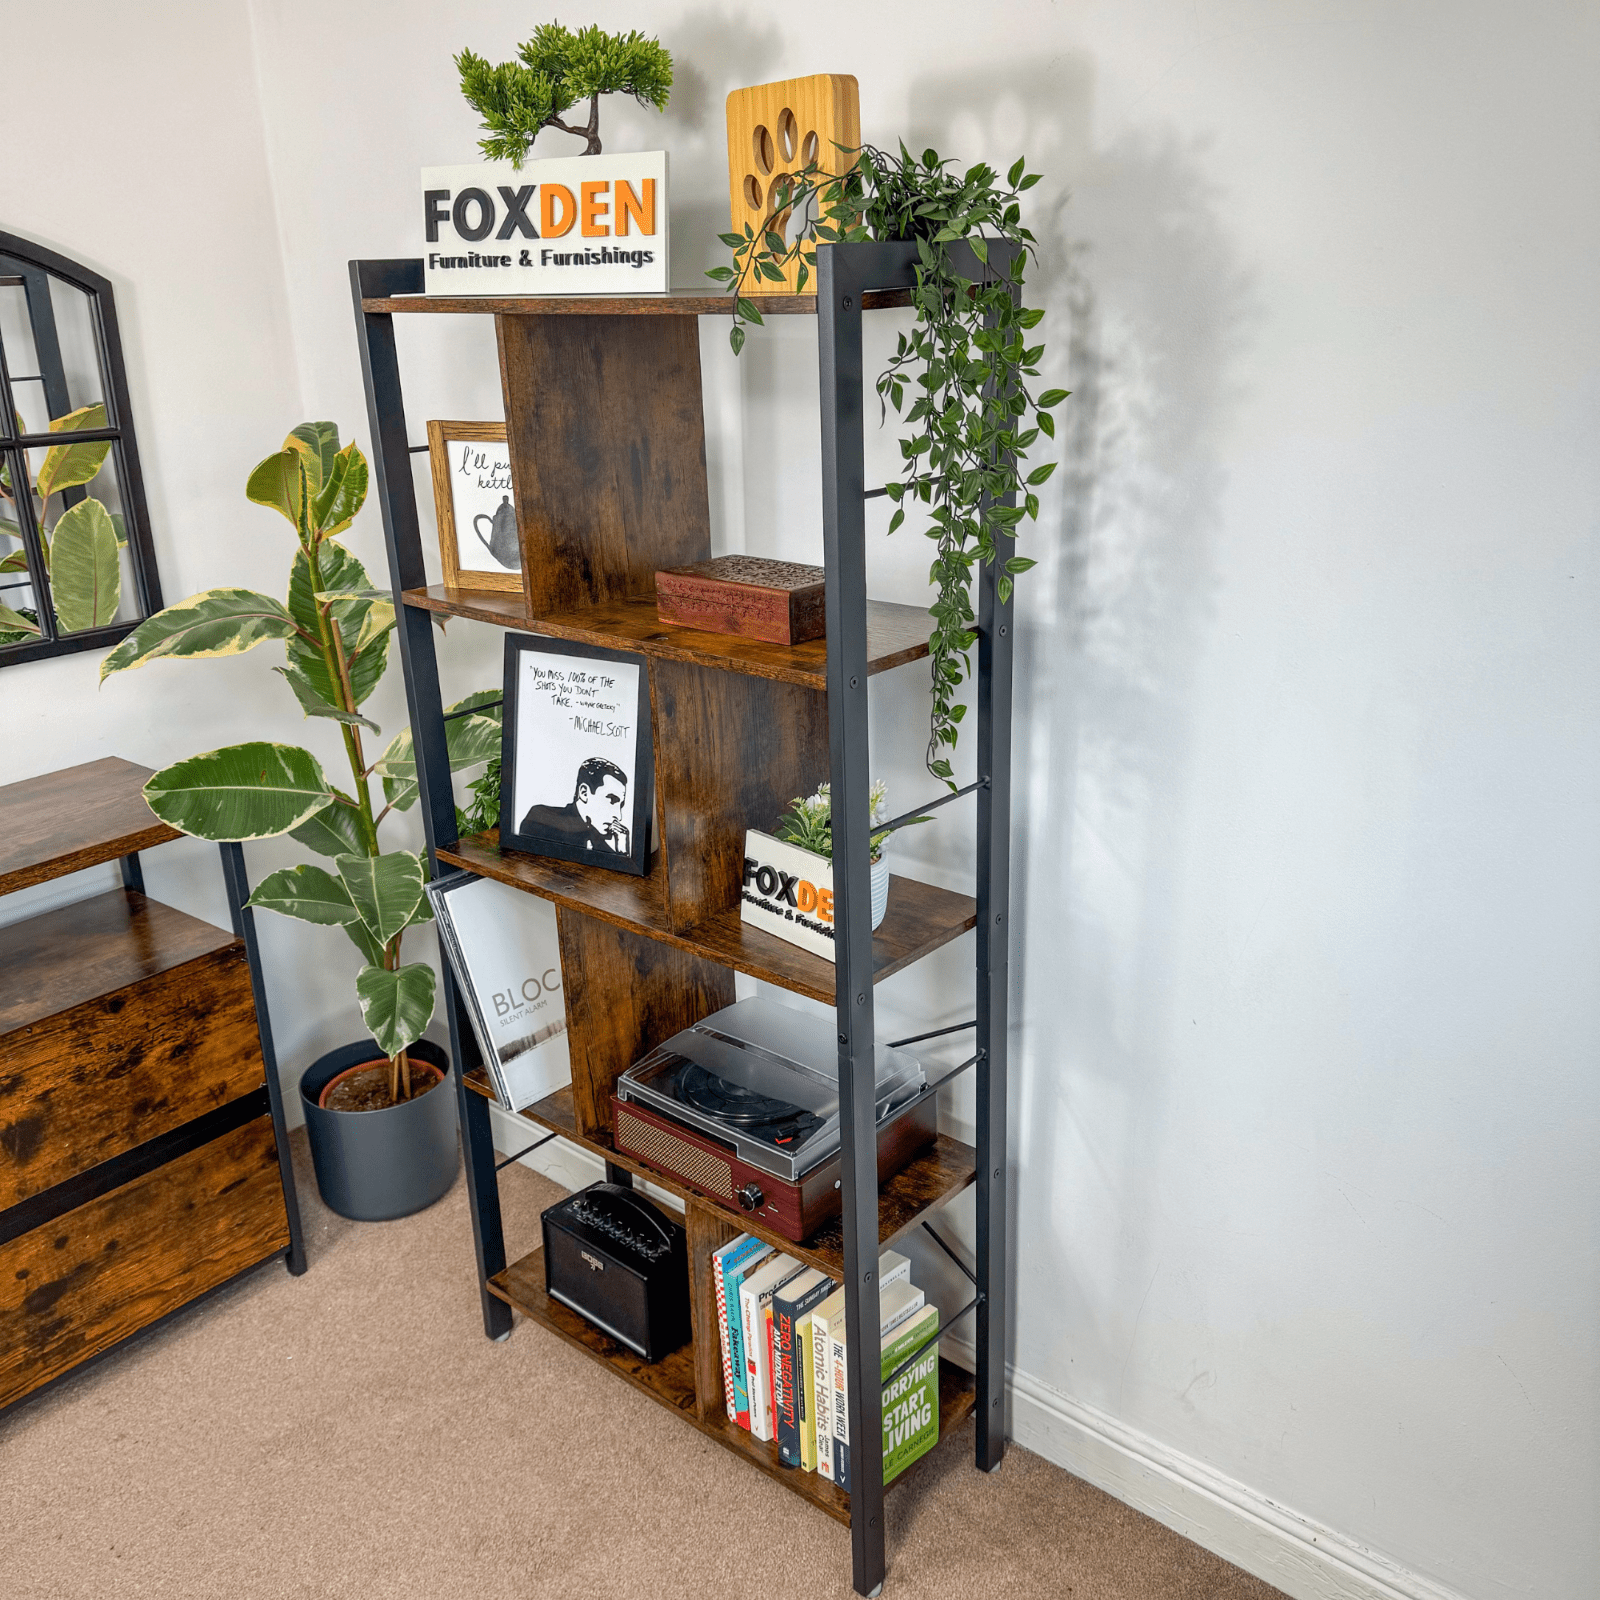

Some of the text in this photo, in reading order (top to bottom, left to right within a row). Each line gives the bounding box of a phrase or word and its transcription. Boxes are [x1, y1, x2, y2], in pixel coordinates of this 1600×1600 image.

[424, 178, 656, 242] FOXDEN
[428, 246, 654, 270] Furniture & Furnishings
[478, 474, 513, 490] kettl
[490, 461, 511, 478] pu
[535, 681, 556, 690] SHOTS
[558, 683, 573, 697] YOU
[567, 671, 586, 683] 100%
[588, 676, 599, 684] OF
[600, 676, 616, 689] THE
[551, 694, 573, 708] TAKE.
[606, 721, 630, 739] SCOTT
[742, 857, 834, 923] FOXDE
[784, 909, 794, 921] &
[491, 968, 561, 1017] BLOC
[499, 999, 548, 1027] SILENT ALARM
[796, 1301, 805, 1311] THE
[804, 1290, 820, 1306] SUNDAY
[833, 1342, 844, 1361] THE
[773, 1326, 784, 1407] ANT MIDDLETON
[780, 1312, 795, 1430] ZERO NEGATIVITY
[814, 1323, 831, 1432] Atomic Habits
[834, 1360, 845, 1392] 4-HOUR
[881, 1355, 935, 1408] ORRYING
[835, 1391, 846, 1418] WORK
[883, 1385, 927, 1432] START
[836, 1414, 847, 1440] WEEK
[896, 1425, 936, 1461] CARNEGIE
